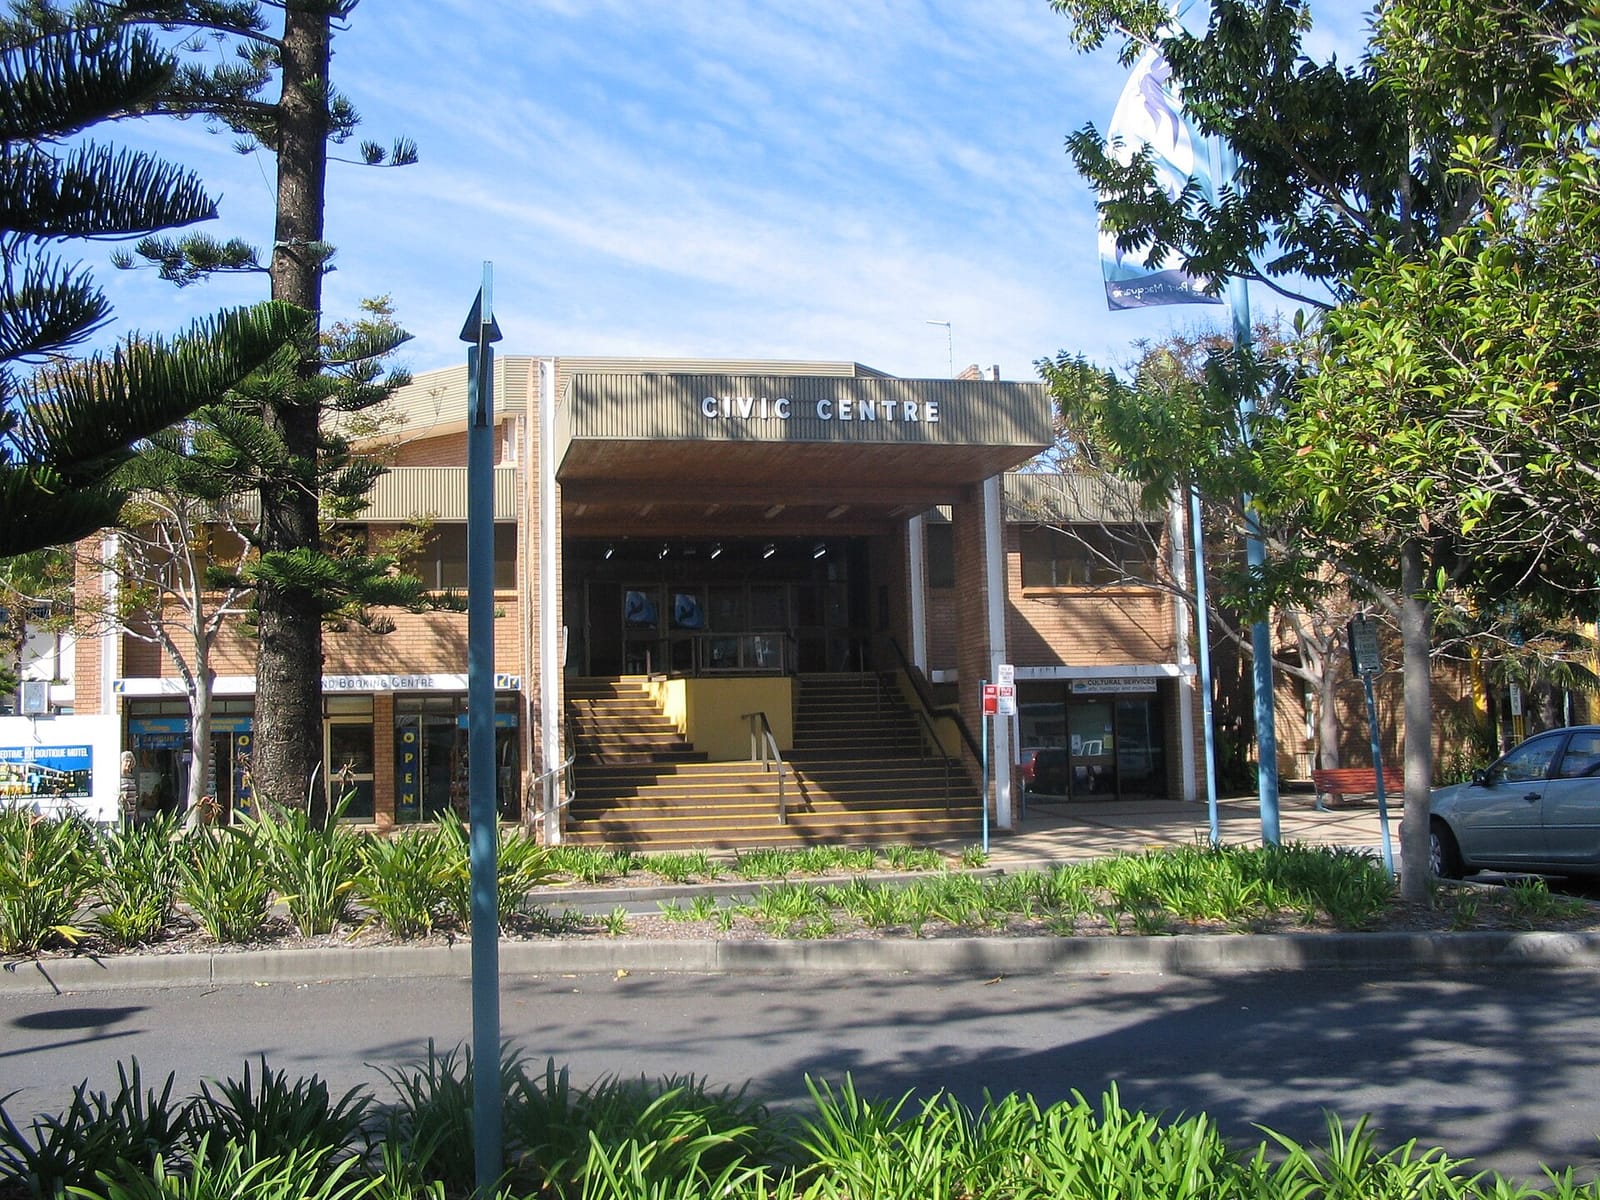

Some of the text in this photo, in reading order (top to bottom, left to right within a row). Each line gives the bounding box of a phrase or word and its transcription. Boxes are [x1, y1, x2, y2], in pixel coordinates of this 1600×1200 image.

[701, 396, 940, 421] CIVIC CENTRE
[339, 678, 388, 688] BOOKING
[391, 677, 434, 688] CENTRE
[34, 749, 67, 758] BOUTIQUE
[402, 732, 415, 805] OPEN
